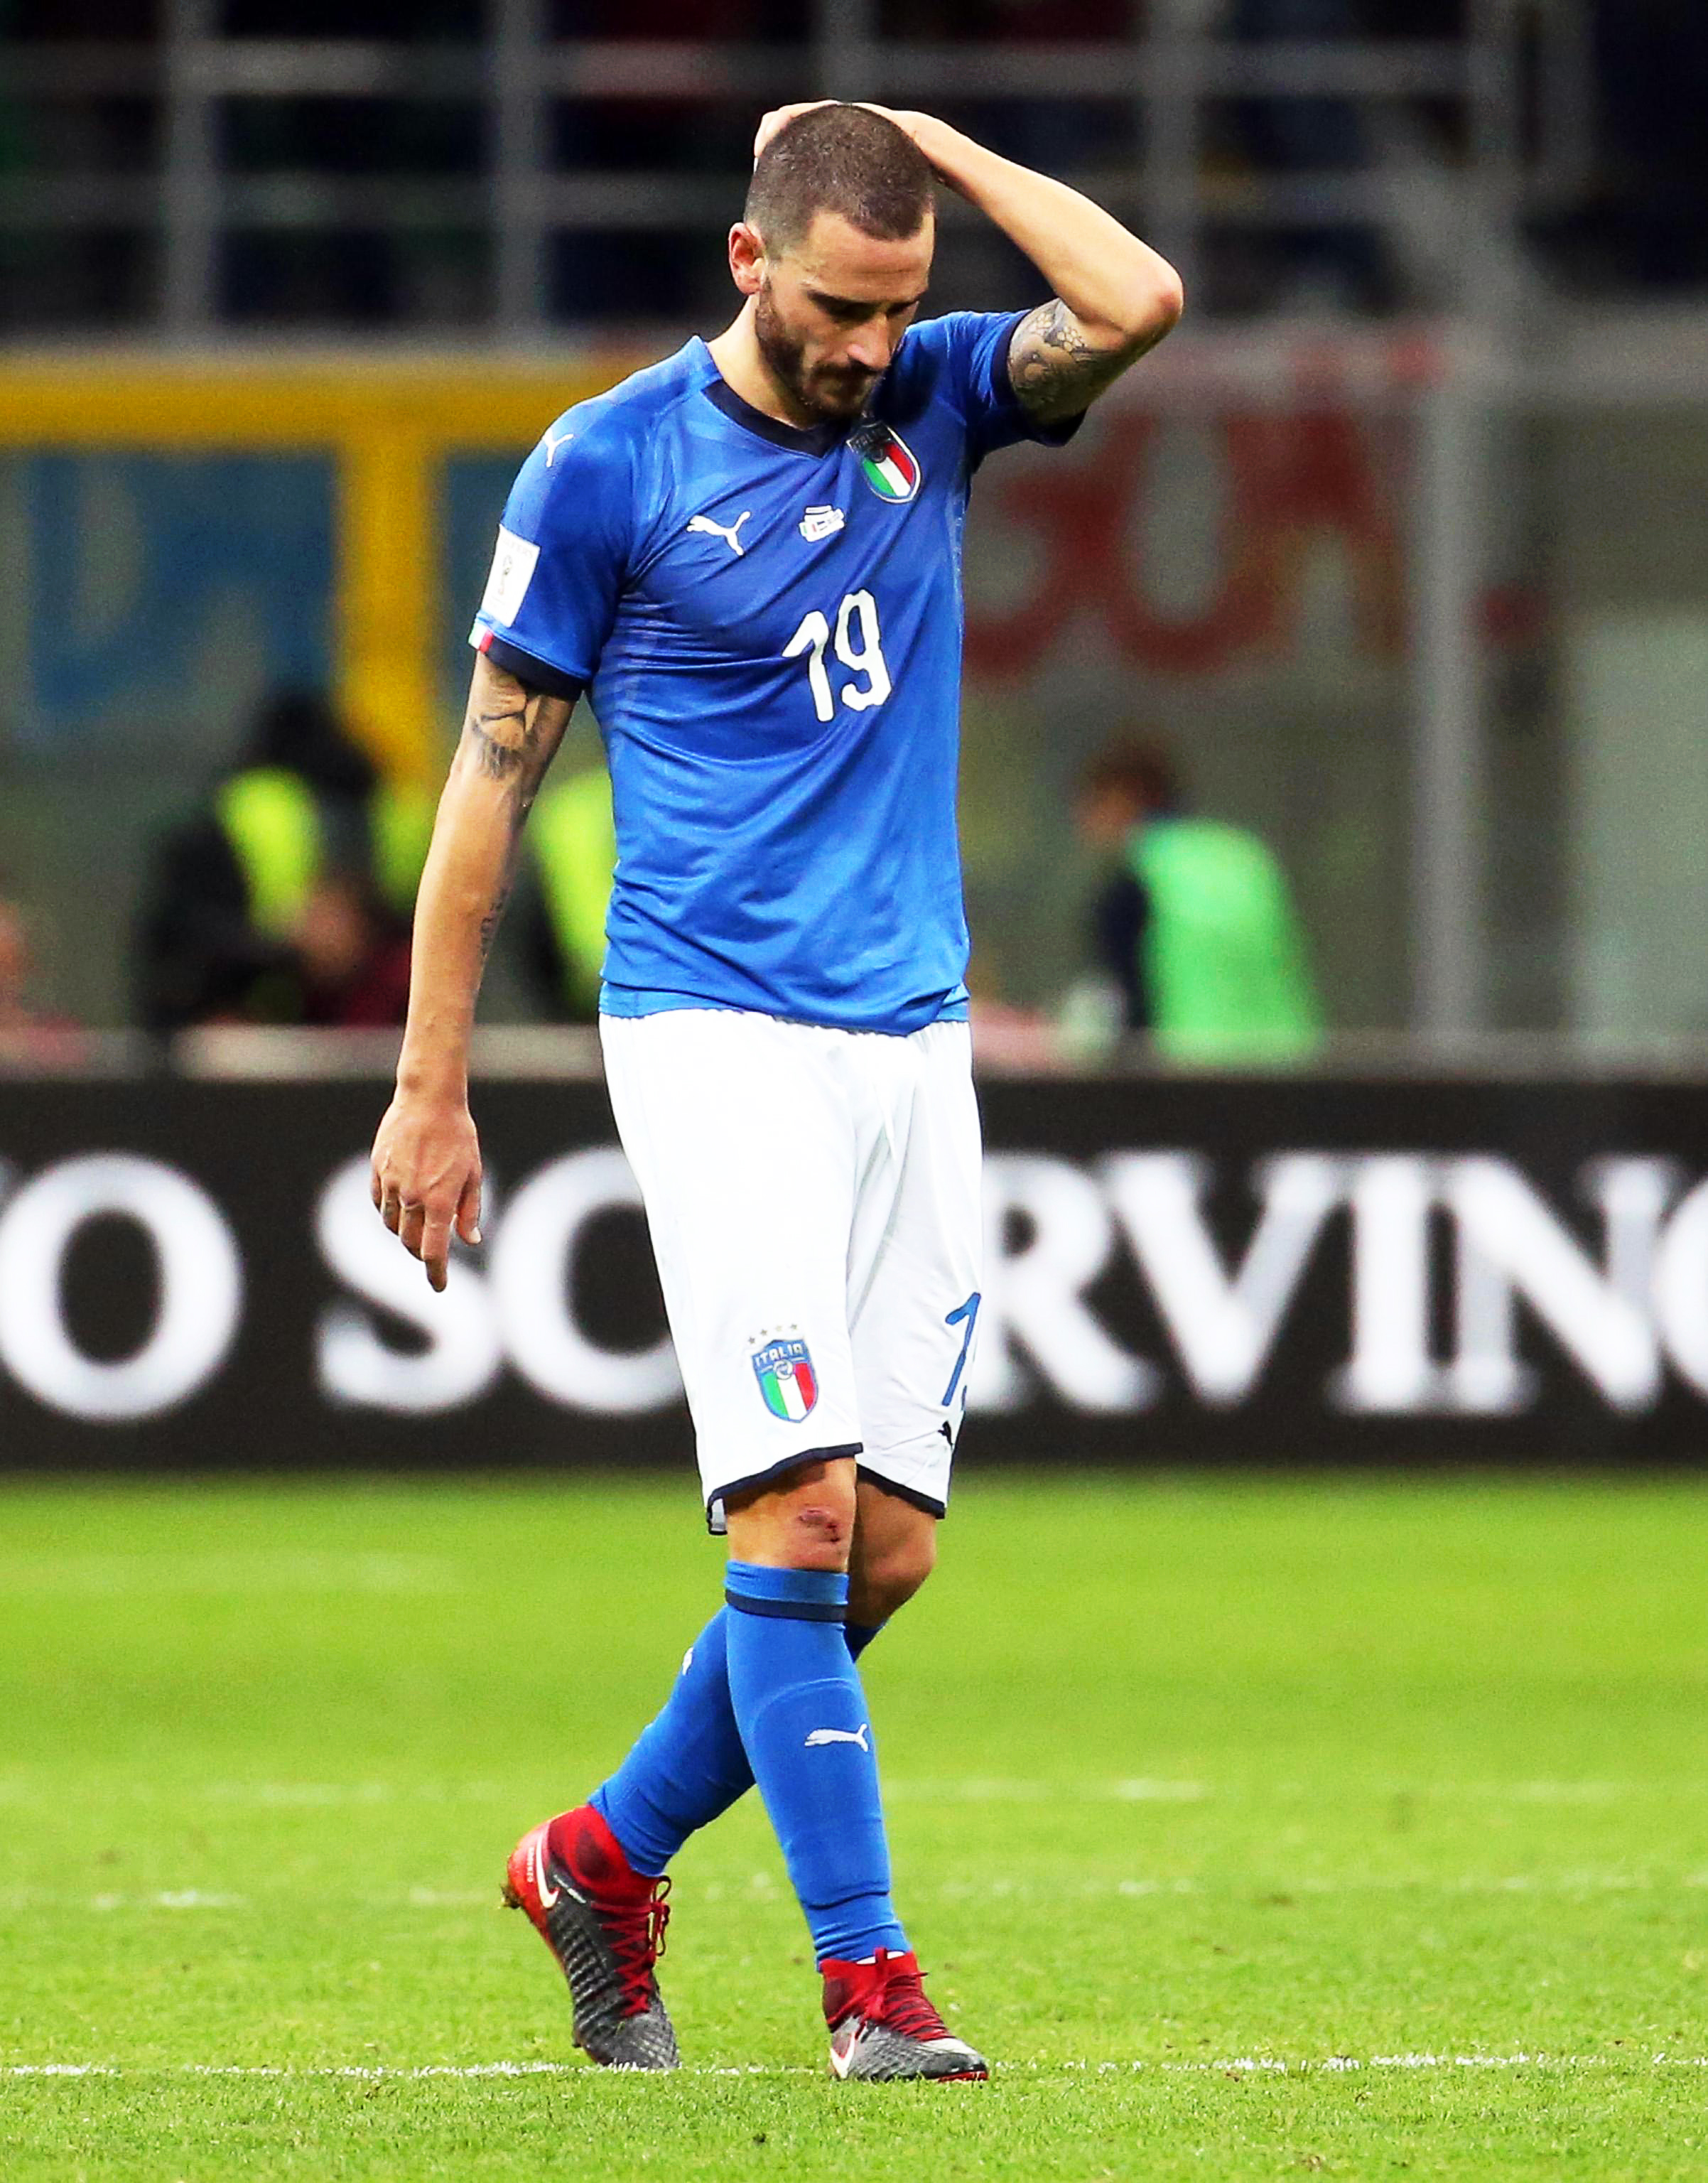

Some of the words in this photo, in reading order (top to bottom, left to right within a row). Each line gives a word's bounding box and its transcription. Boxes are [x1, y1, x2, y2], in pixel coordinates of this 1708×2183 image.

[782, 588, 892, 723] 19
[0, 1150, 243, 1421] O
[754, 1343, 804, 1367] ITALIA
[941, 1292, 981, 1411] 1
